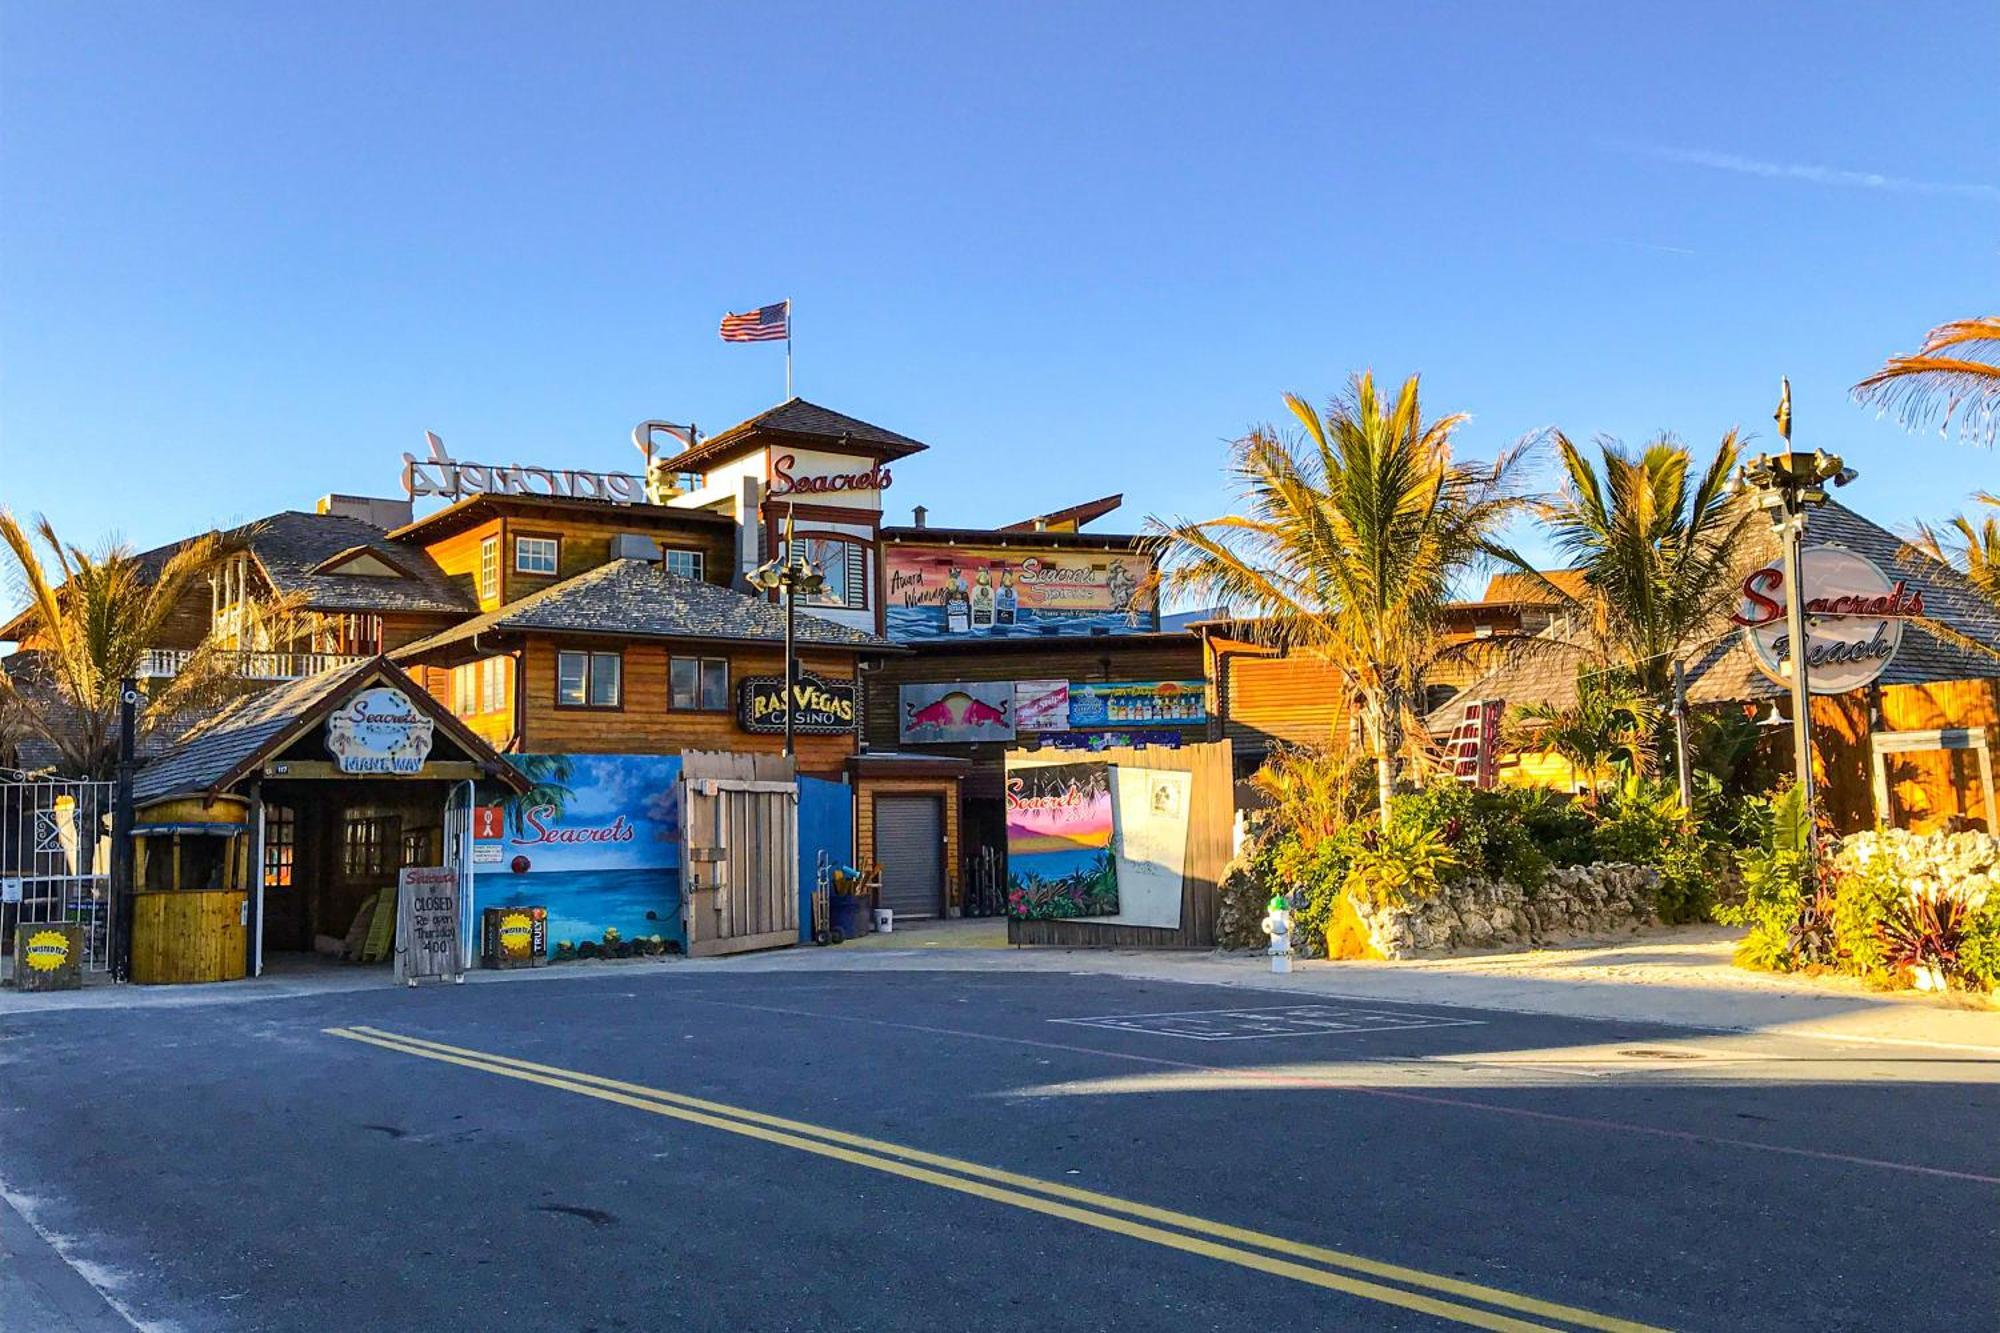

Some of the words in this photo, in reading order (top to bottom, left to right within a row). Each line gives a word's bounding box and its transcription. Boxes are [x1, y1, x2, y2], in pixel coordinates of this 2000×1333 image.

[770, 454, 893, 497] Seacrets
[891, 568, 924, 595] Award
[1019, 557, 1096, 585] Seacrets
[1731, 567, 1925, 626] Sacrets
[350, 700, 417, 723] Seacrets
[793, 684, 852, 720] VEGAS
[1007, 777, 1083, 810] Seacrets
[511, 804, 634, 845] Seacrets
[414, 896, 453, 912] CLOSED
[533, 920, 542, 952] TRULY
